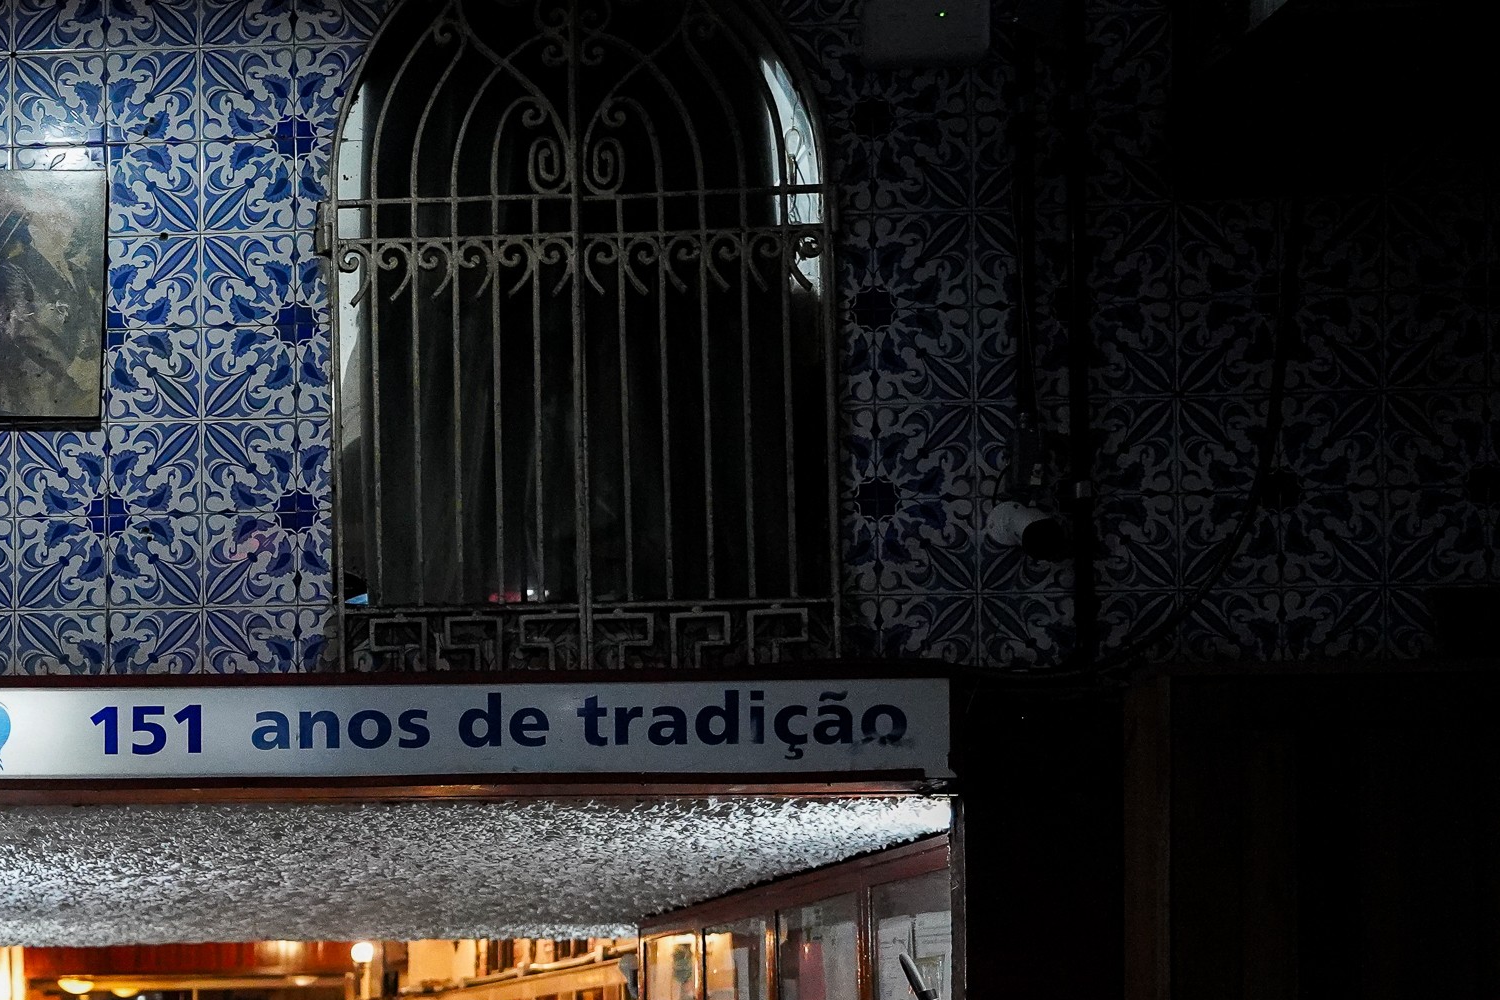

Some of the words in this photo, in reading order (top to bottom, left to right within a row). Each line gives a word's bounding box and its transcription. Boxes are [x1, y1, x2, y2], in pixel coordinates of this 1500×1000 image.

[90, 704, 203, 756] 151
[250, 706, 430, 751] anos
[457, 692, 550, 748] de
[577, 690, 909, 759] tradição
